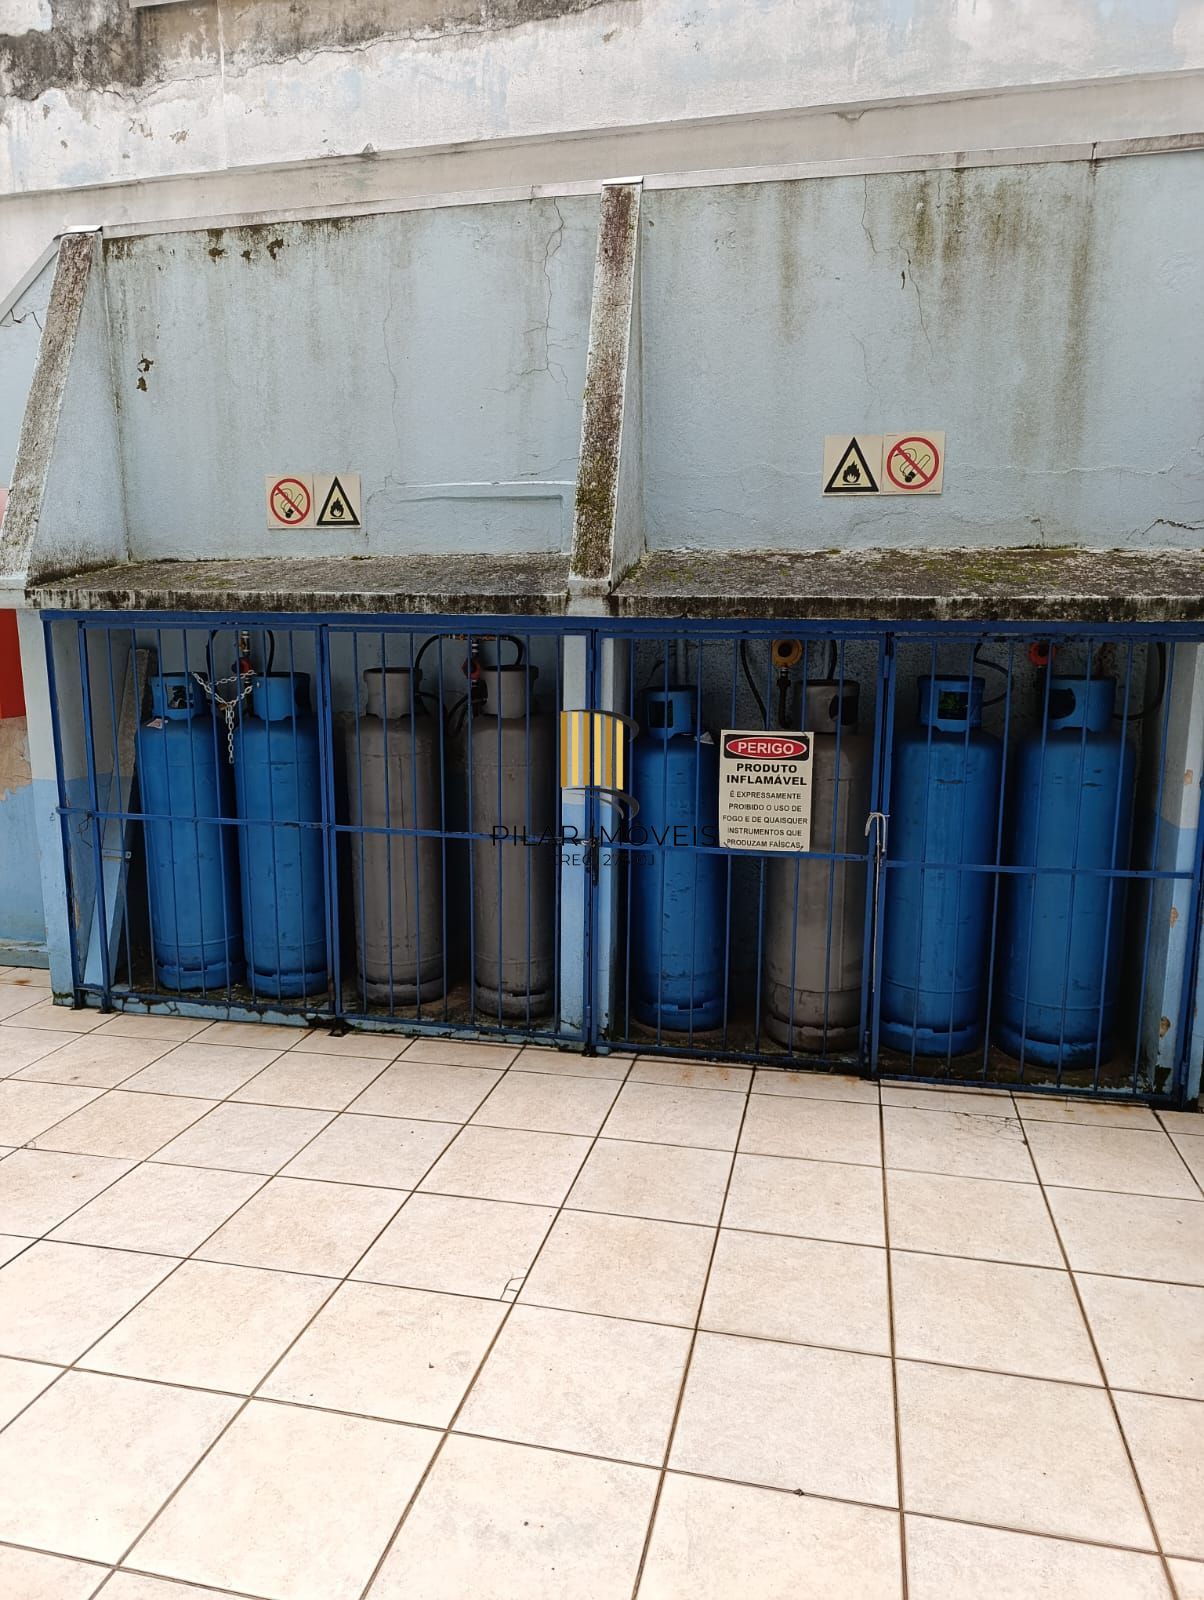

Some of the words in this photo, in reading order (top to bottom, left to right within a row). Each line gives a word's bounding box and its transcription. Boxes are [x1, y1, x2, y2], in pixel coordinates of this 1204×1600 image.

[738, 742, 794, 754] PERIGO
[737, 763, 797, 773] PRODUTO
[726, 774, 807, 786] INFLAMÁVEL
[736, 791, 802, 800] EXPRESSAMENTE
[728, 803, 763, 811] PROIBIDO
[774, 804, 789, 812] USO
[722, 815, 743, 823] FOGO
[745, 815, 749, 823] E
[752, 815, 762, 823] DE
[763, 816, 808, 825] QUAISQUER
[727, 827, 784, 836] INSTRUMENTOS
[786, 828, 802, 837] QUE
[727, 838, 768, 848] PRODUZAM
